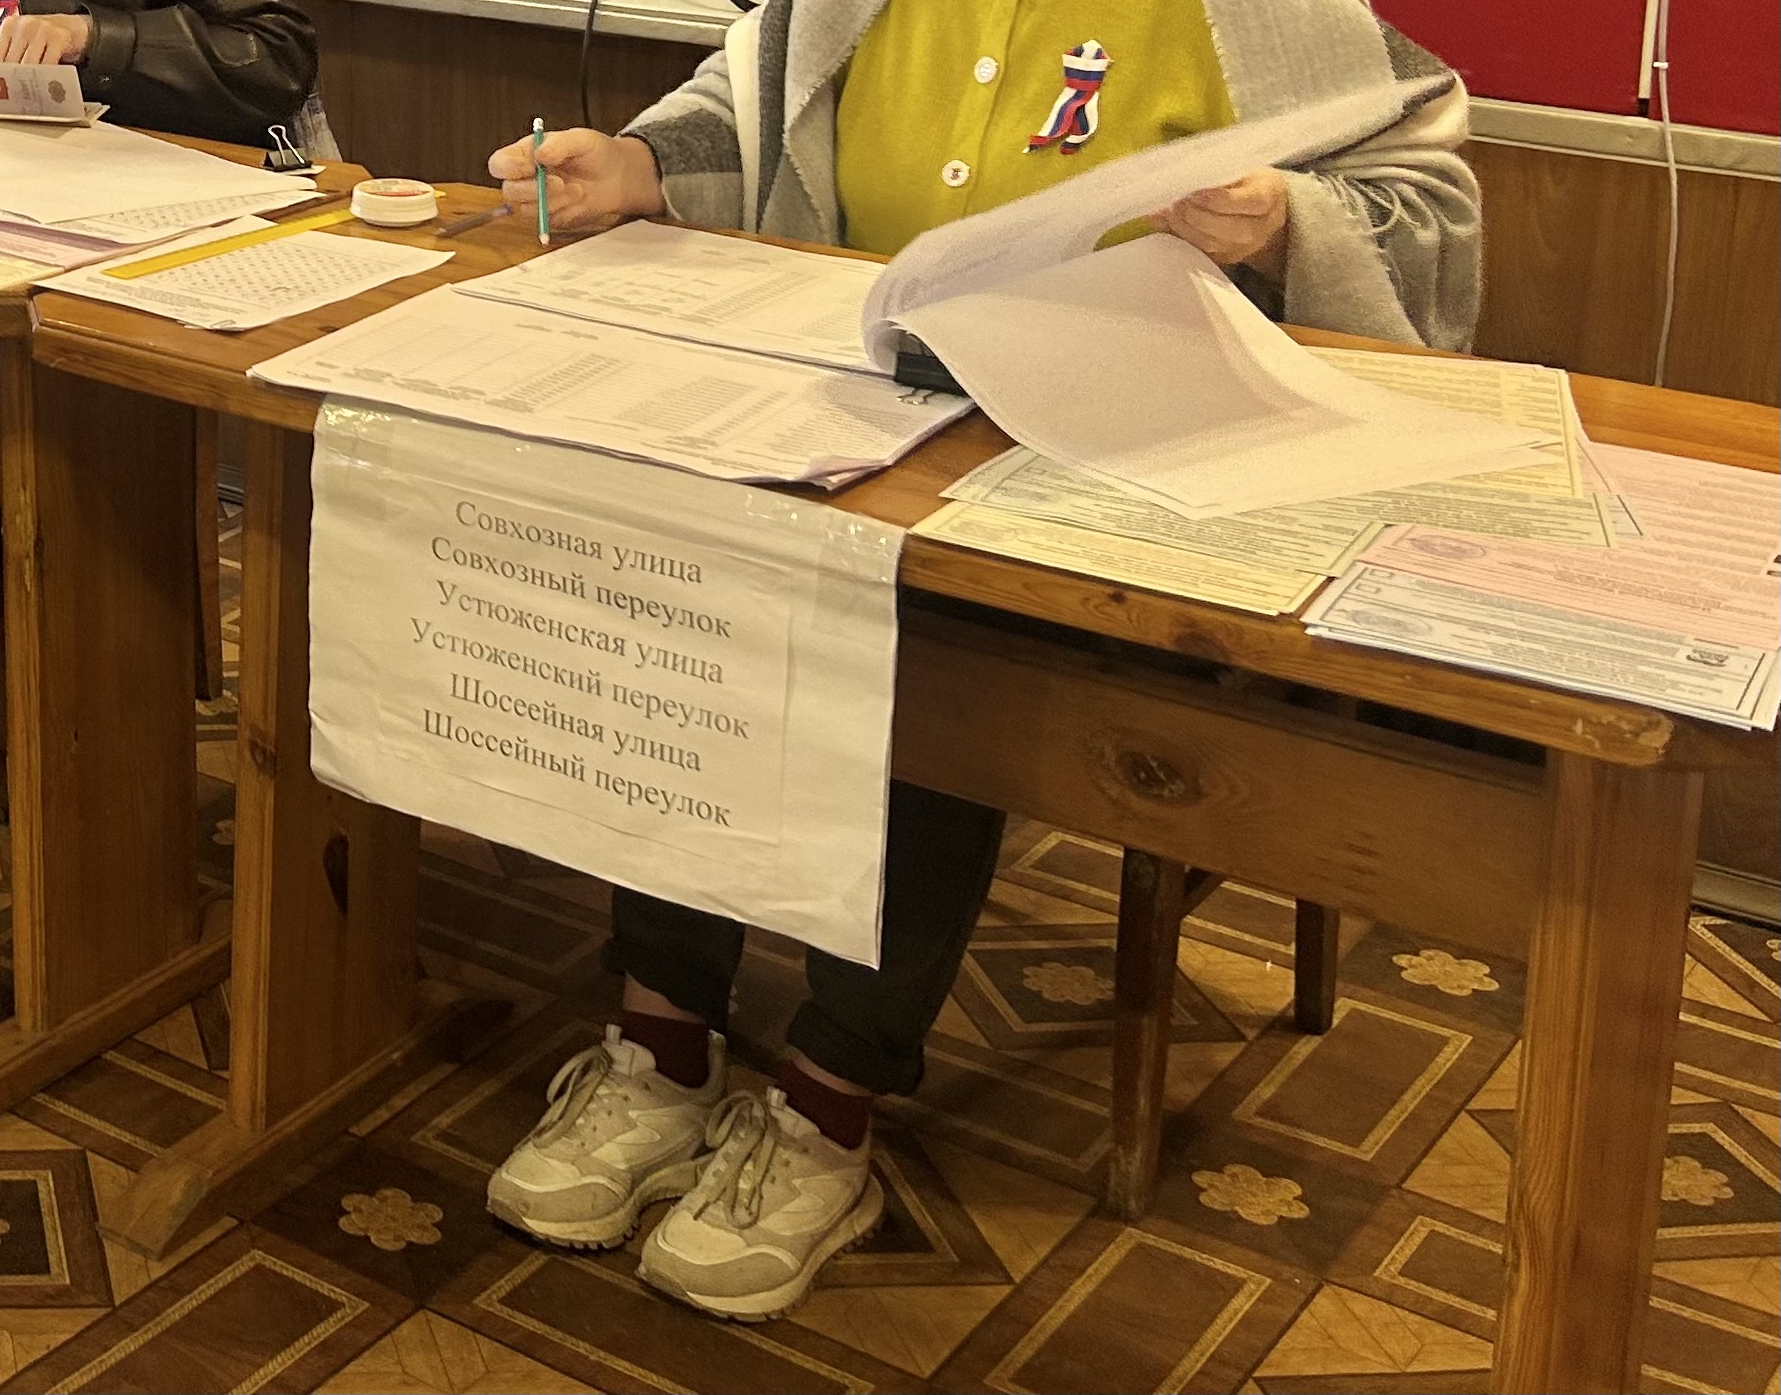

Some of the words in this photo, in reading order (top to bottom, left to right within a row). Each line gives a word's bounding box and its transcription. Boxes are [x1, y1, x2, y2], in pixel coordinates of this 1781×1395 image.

[431, 536, 586, 599] Совхозный
[595, 585, 732, 638] переулок
[455, 501, 602, 560] Совхозная
[612, 546, 702, 585] улица
[410, 617, 602, 697] Устюженский
[612, 683, 750, 740] переулок
[436, 580, 626, 656] Устюженская
[634, 642, 723, 684] улица
[423, 708, 586, 782] Шоссейный
[595, 769, 732, 828] переулок
[613, 729, 702, 772] улица
